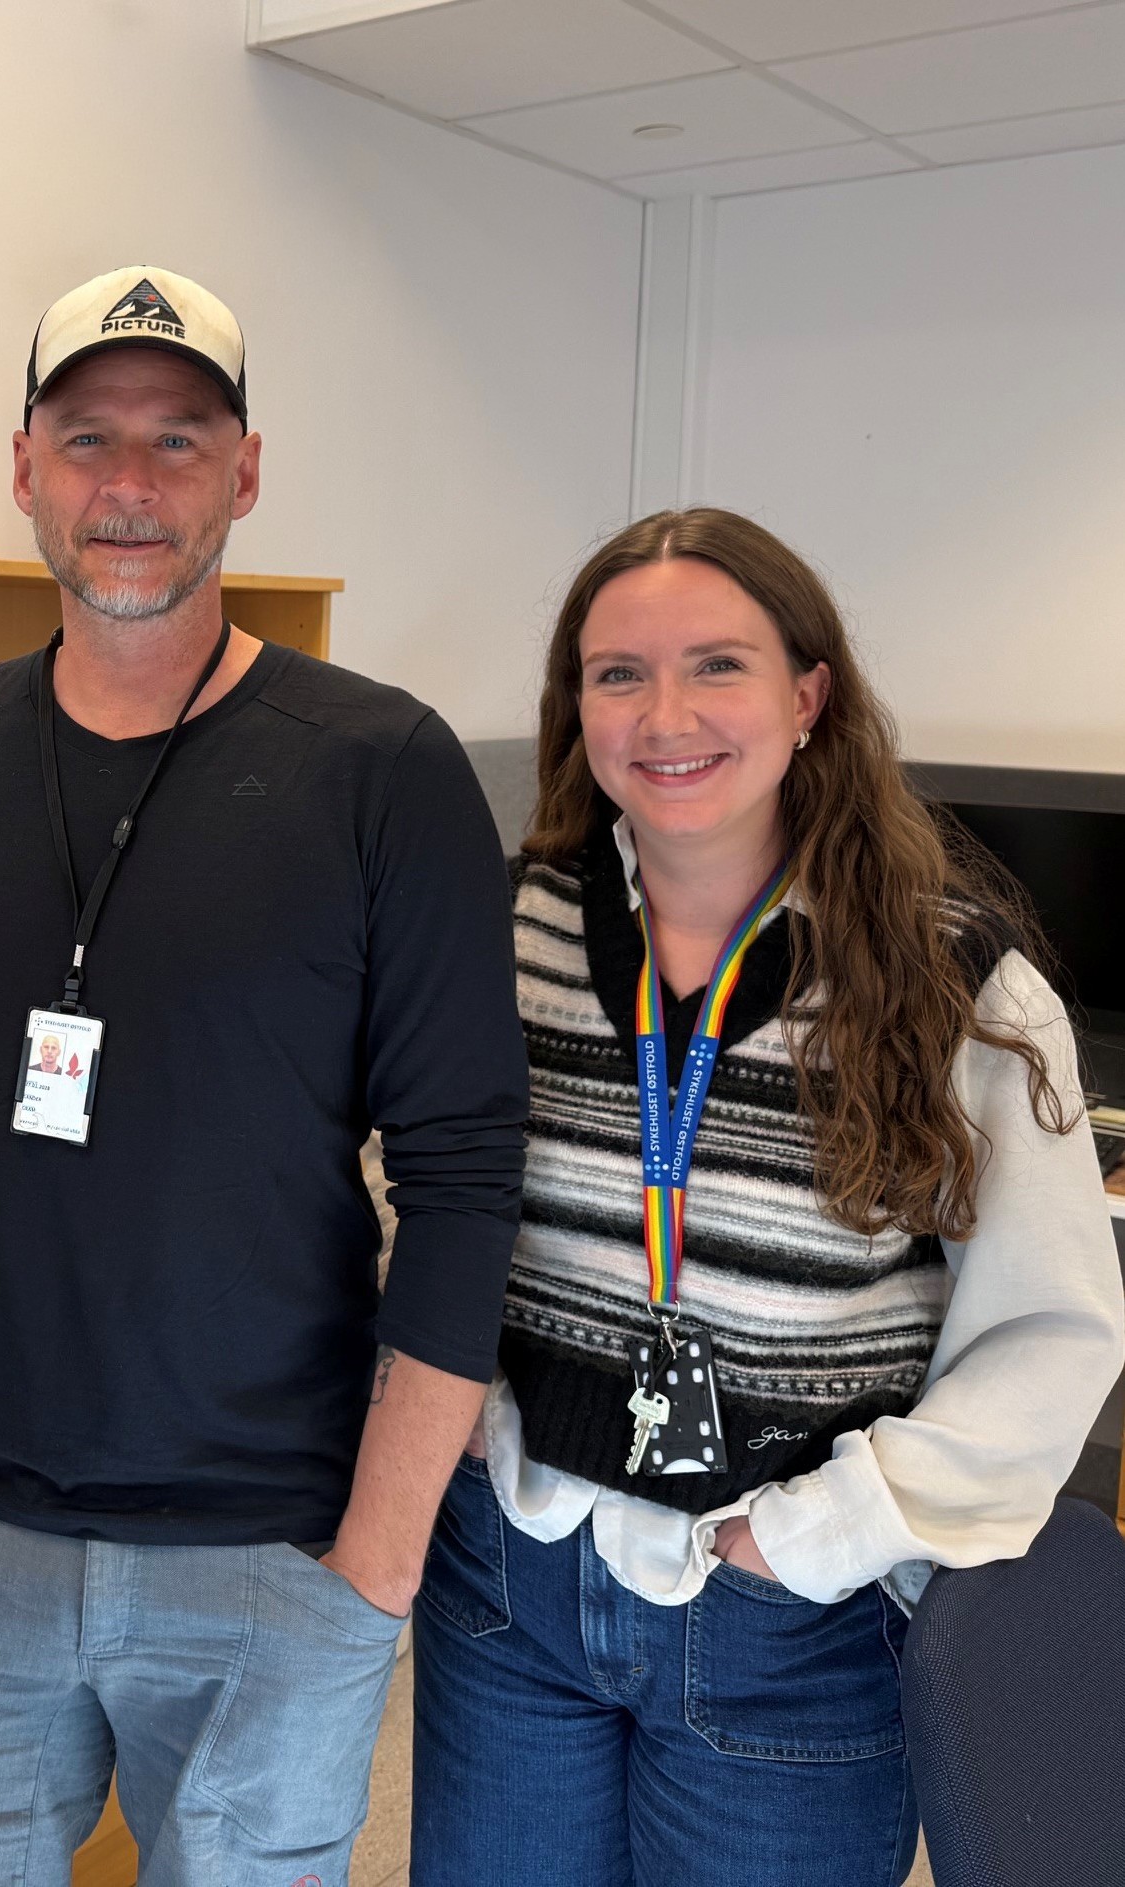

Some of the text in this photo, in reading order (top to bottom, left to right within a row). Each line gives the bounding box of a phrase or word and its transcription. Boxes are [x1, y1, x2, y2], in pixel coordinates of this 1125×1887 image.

[101, 319, 185, 339] PICTURE
[645, 1040, 660, 1151] SYKEHUSET ØSTFOLD
[672, 1069, 703, 1180] SYKEHUSET ØSTFOLD
